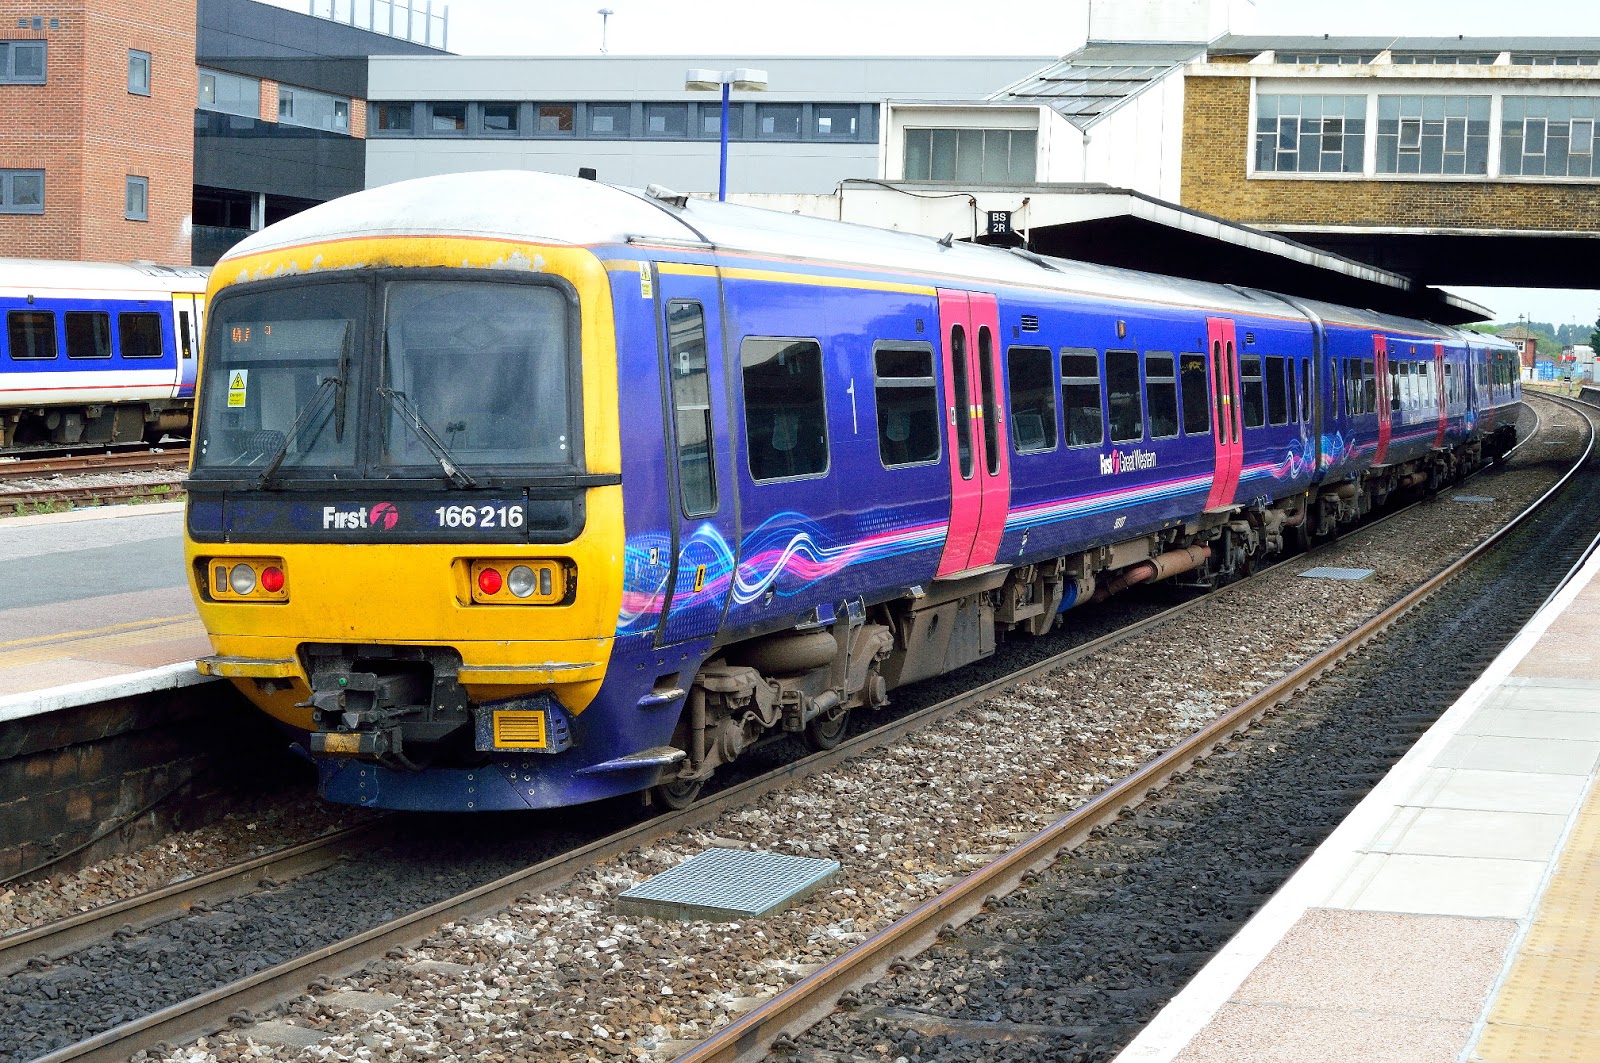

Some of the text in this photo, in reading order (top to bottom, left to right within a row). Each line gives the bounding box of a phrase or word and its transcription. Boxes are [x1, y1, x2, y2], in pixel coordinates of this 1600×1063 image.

[992, 212, 1006, 222] BS
[992, 223, 1006, 233] 2R
[846, 378, 858, 435] 1
[1099, 449, 1157, 475] First Great Western
[323, 505, 523, 529] First 166216
